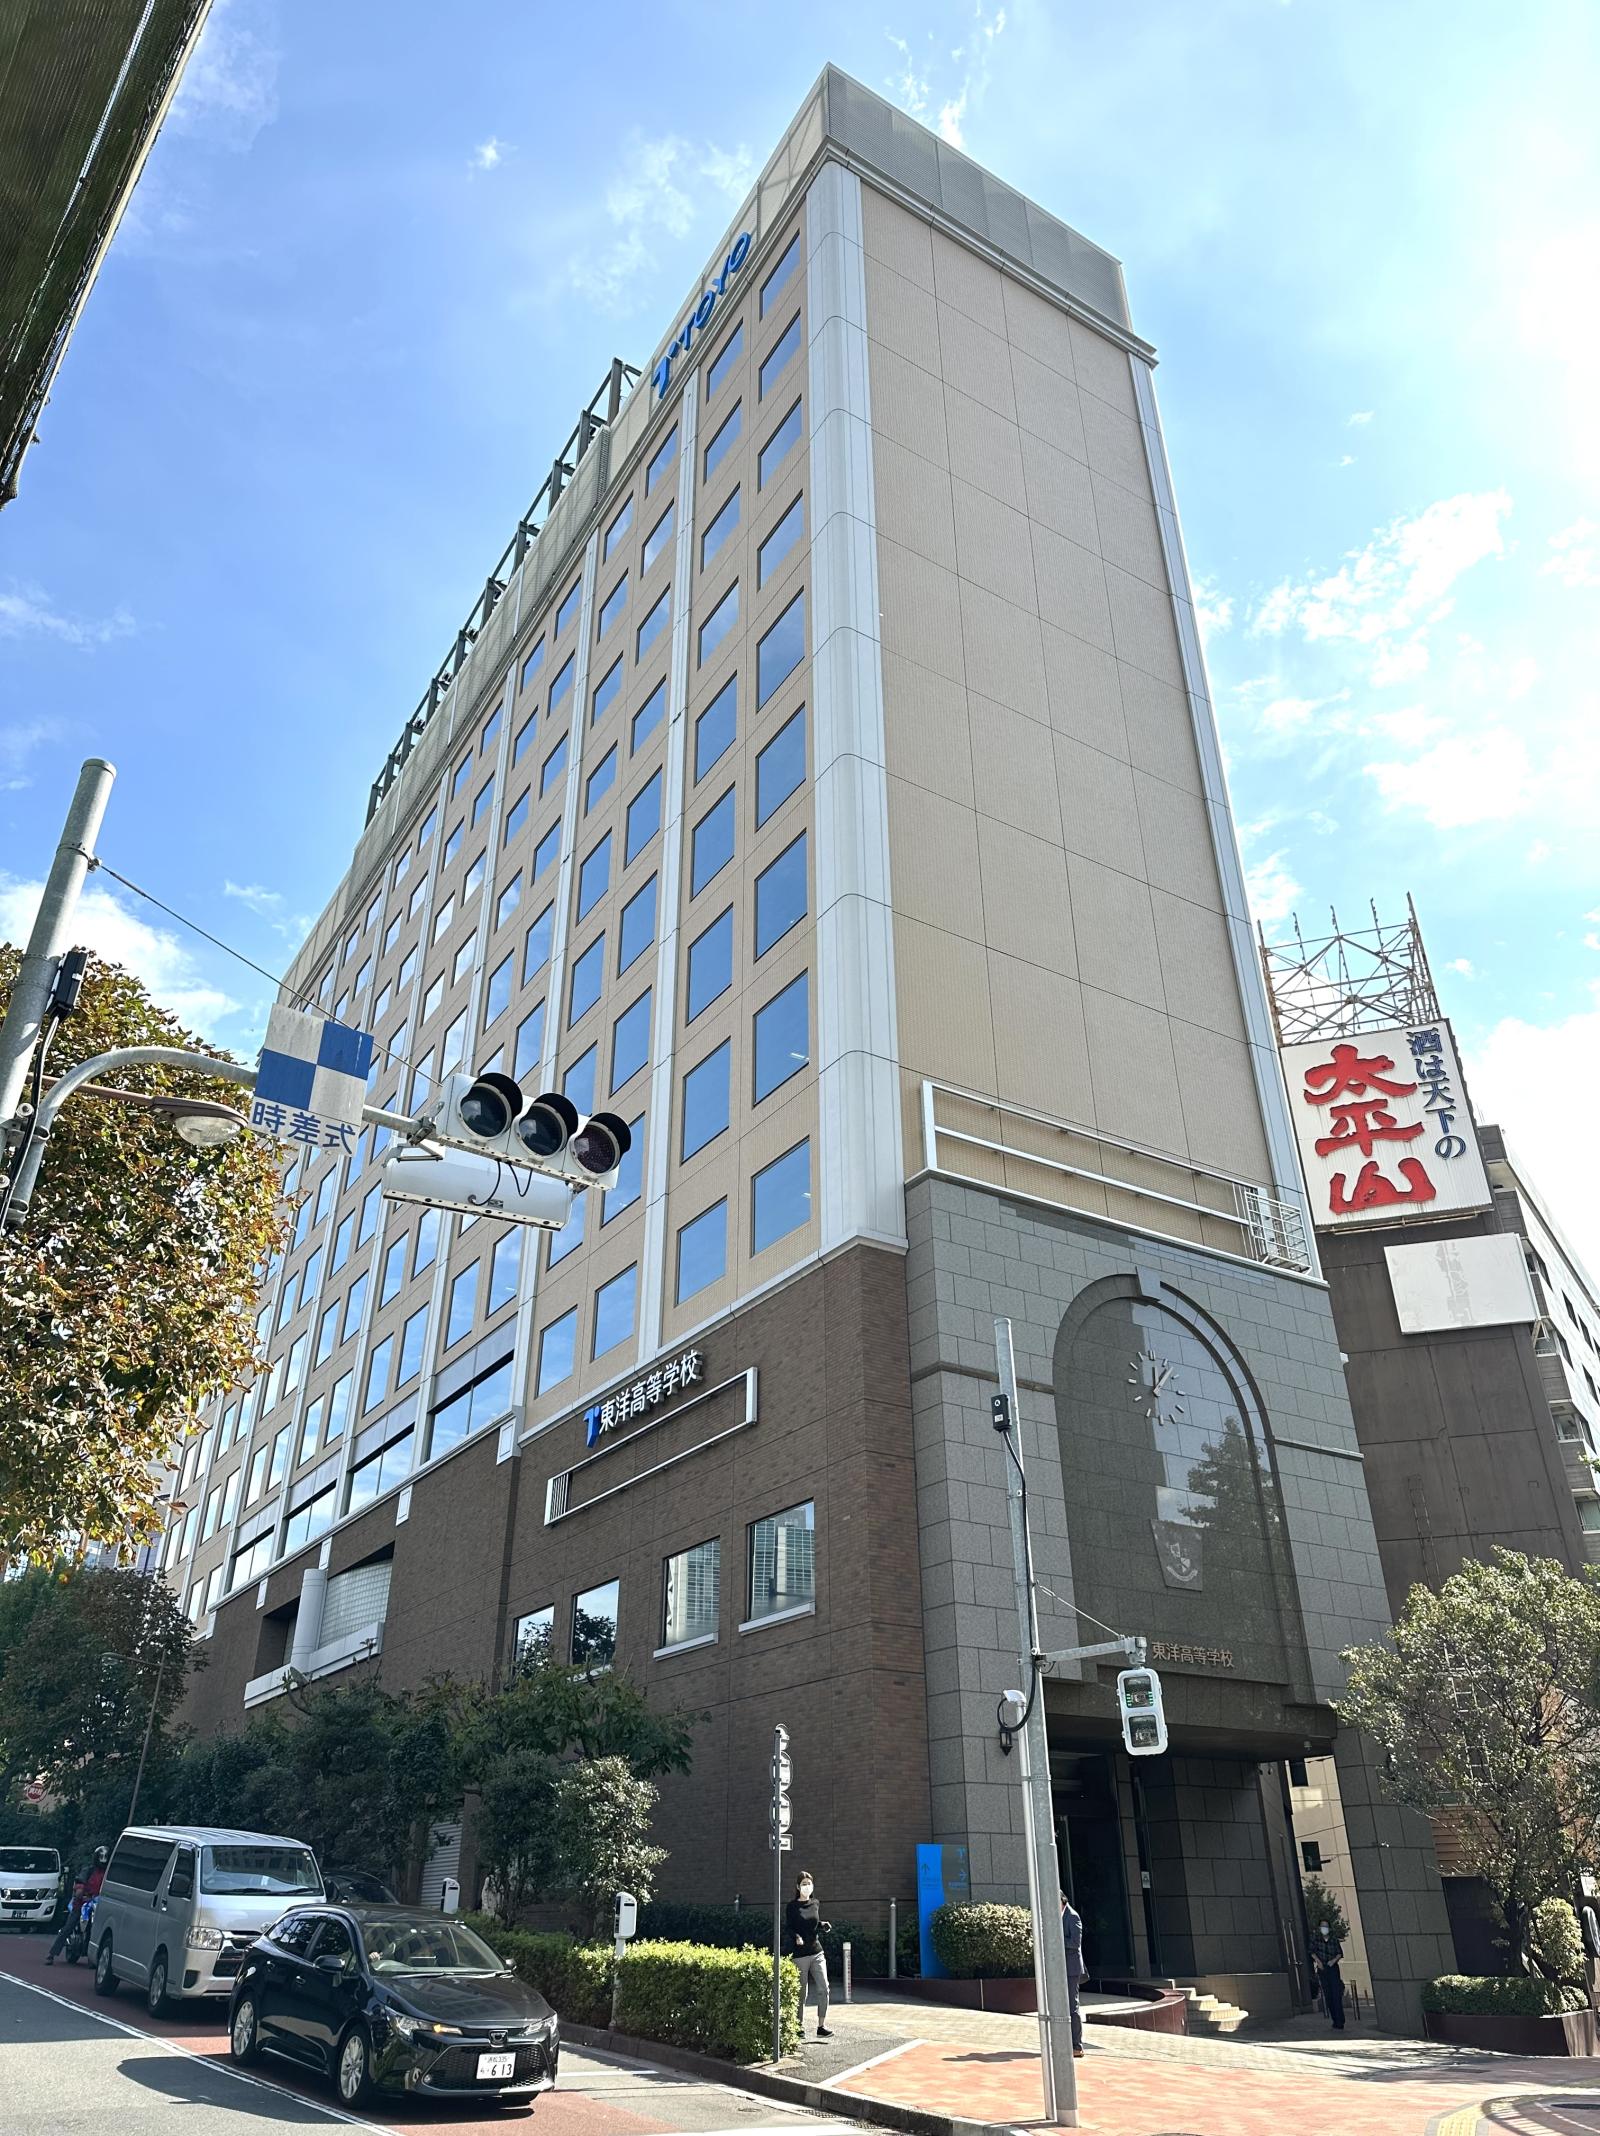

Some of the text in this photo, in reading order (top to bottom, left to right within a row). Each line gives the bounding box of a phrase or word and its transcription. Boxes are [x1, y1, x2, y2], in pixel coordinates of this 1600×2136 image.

[678, 231, 752, 351] TOYO
[252, 1101, 356, 1155] 時差式
[1303, 1043, 1437, 1216] 太平山
[1406, 1026, 1467, 1160] 酒は天下の
[599, 1349, 700, 1434] 東洋高等学校
[1151, 1641, 1235, 1668] 東洋高等学校
